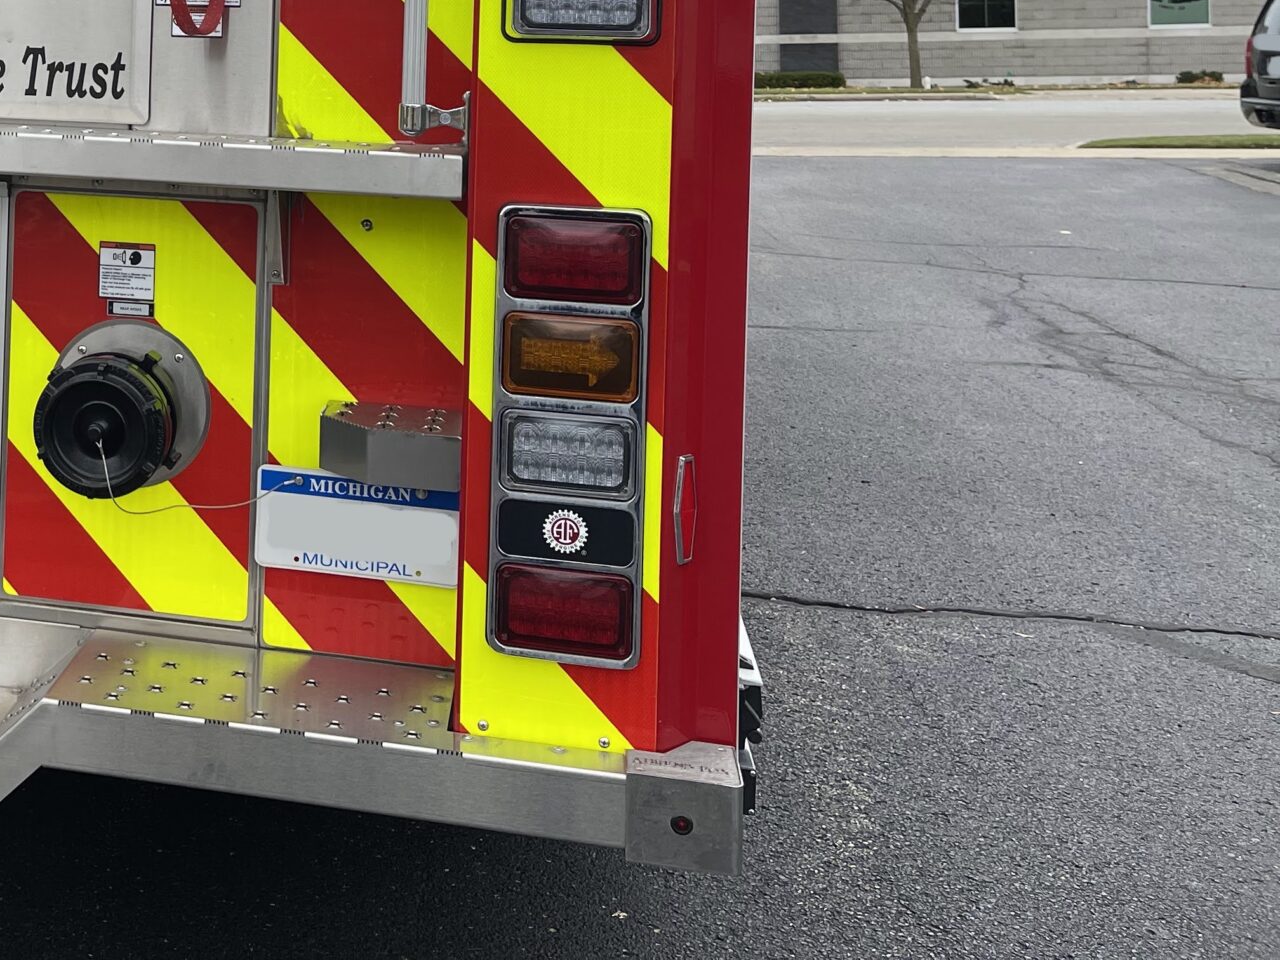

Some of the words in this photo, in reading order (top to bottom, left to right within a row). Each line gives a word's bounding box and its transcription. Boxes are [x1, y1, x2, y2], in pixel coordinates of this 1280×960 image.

[21, 45, 126, 100] Trust
[309, 477, 412, 503] MICHIGAN
[303, 552, 413, 577] MUNICIPAL
